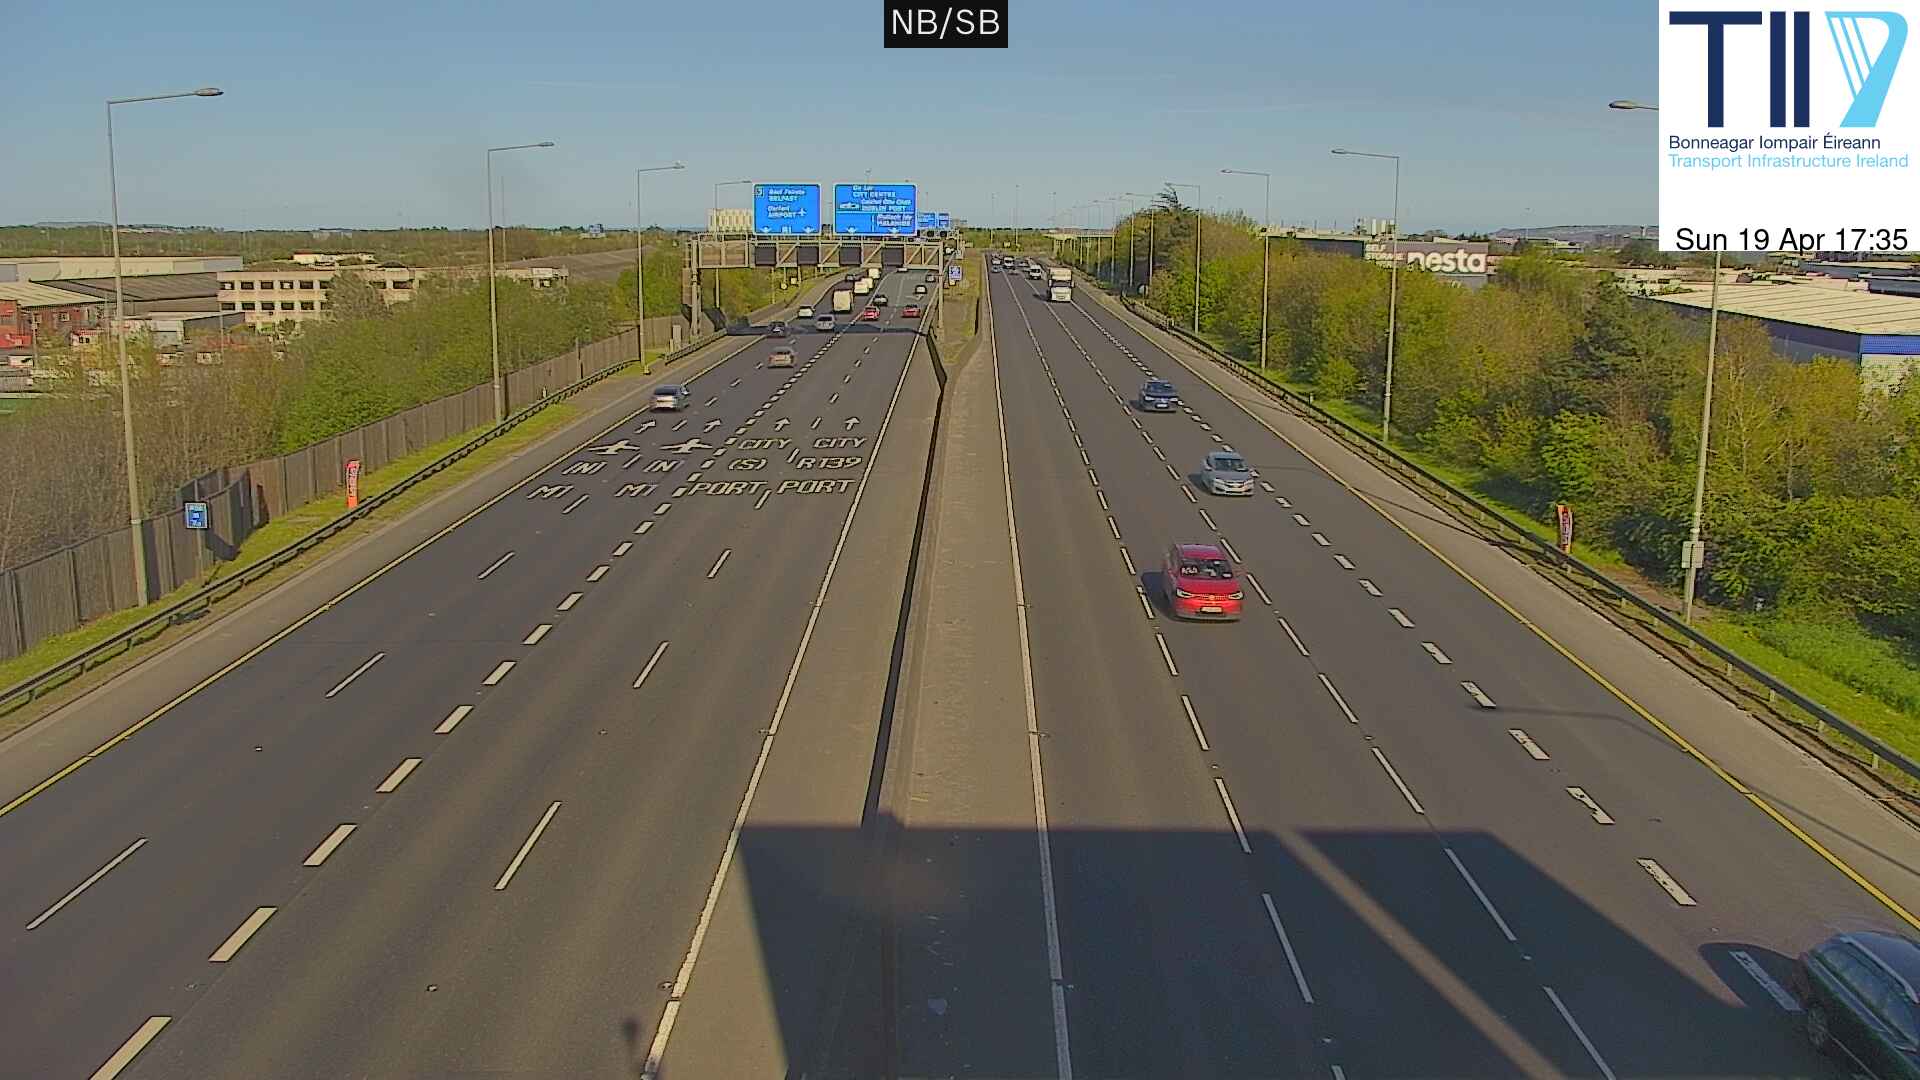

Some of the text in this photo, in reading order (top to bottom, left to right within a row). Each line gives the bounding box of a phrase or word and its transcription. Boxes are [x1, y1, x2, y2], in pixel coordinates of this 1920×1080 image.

[1408, 248, 1488, 273] nesta
[738, 438, 792, 450] CITY
[814, 437, 867, 449] CITY
[728, 459, 768, 471] (S)
[526, 484, 574, 499] M1
[615, 484, 660, 497] M1
[688, 481, 768, 496] PORT
[777, 480, 857, 494] PORT
